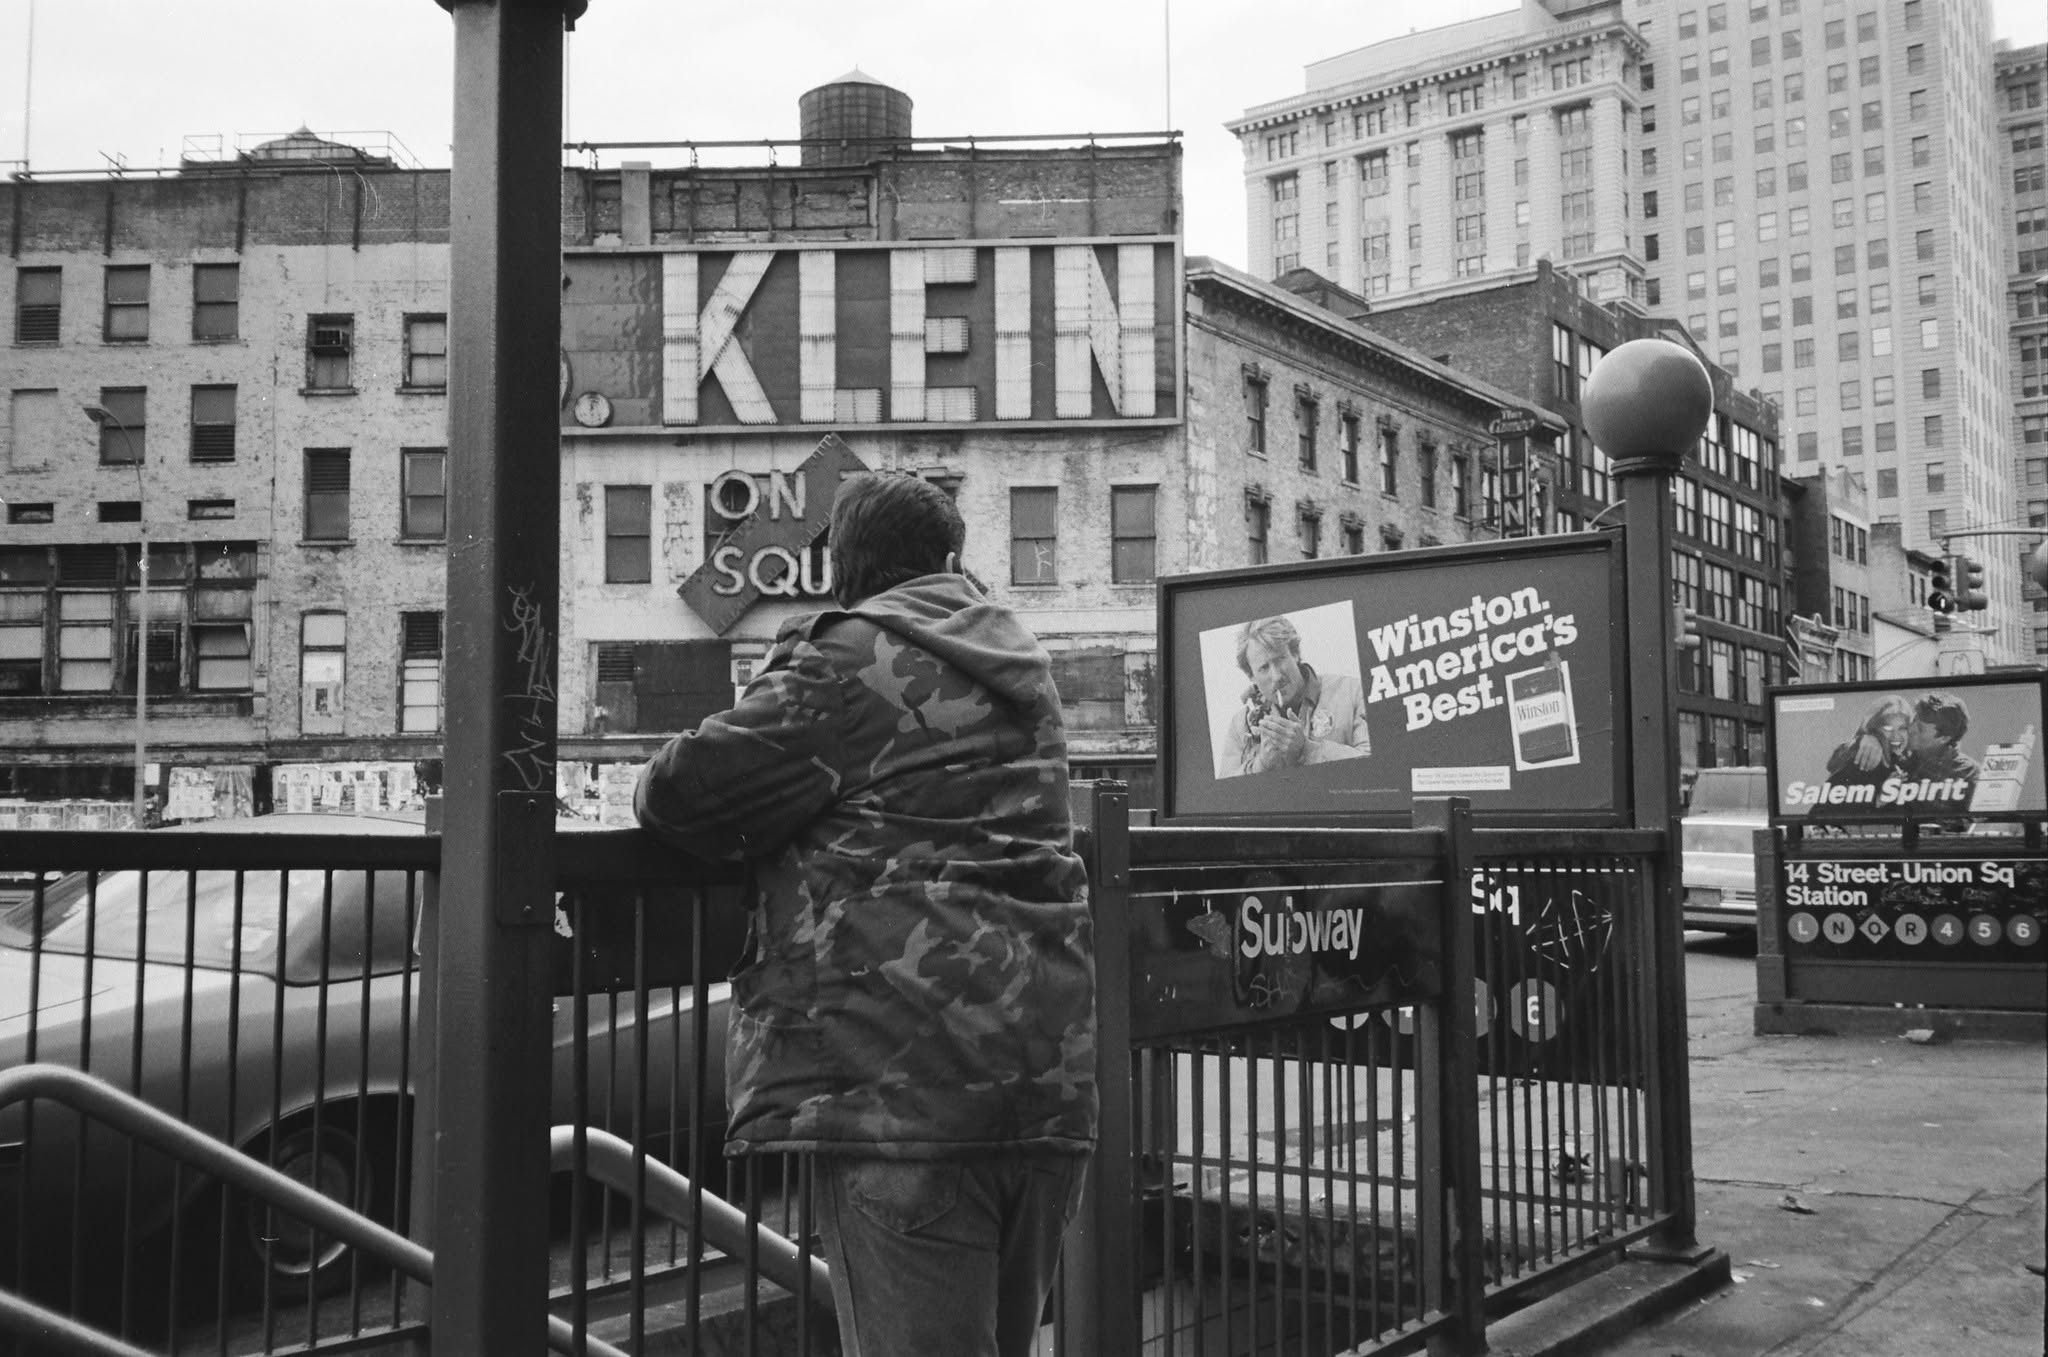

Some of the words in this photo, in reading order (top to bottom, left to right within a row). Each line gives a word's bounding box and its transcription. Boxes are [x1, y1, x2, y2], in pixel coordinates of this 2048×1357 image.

[662, 248, 1156, 425] KLEIN
[711, 470, 806, 519] ON
[713, 545, 832, 597] SQU
[1367, 586, 1551, 662] Winston.
[1367, 614, 1578, 704] America's
[1402, 673, 1504, 732] Best.
[1517, 700, 1560, 721] Winston
[1785, 781, 1876, 805] Salem
[1880, 777, 1969, 806] Spirit
[1471, 873, 1520, 926] Sq
[1784, 863, 1810, 883] 14
[1980, 862, 2015, 888] Sq
[1786, 885, 1868, 906] Station
[1240, 895, 1363, 960] Subway
[1798, 921, 1809, 935] L
[1832, 921, 1845, 935] N
[1867, 921, 1882, 937] Q
[1904, 922, 1917, 937] R
[1940, 922, 1953, 937] 4
[1977, 922, 1992, 938] 5
[2015, 922, 2031, 938] 6
[1526, 995, 1541, 1025] 6
